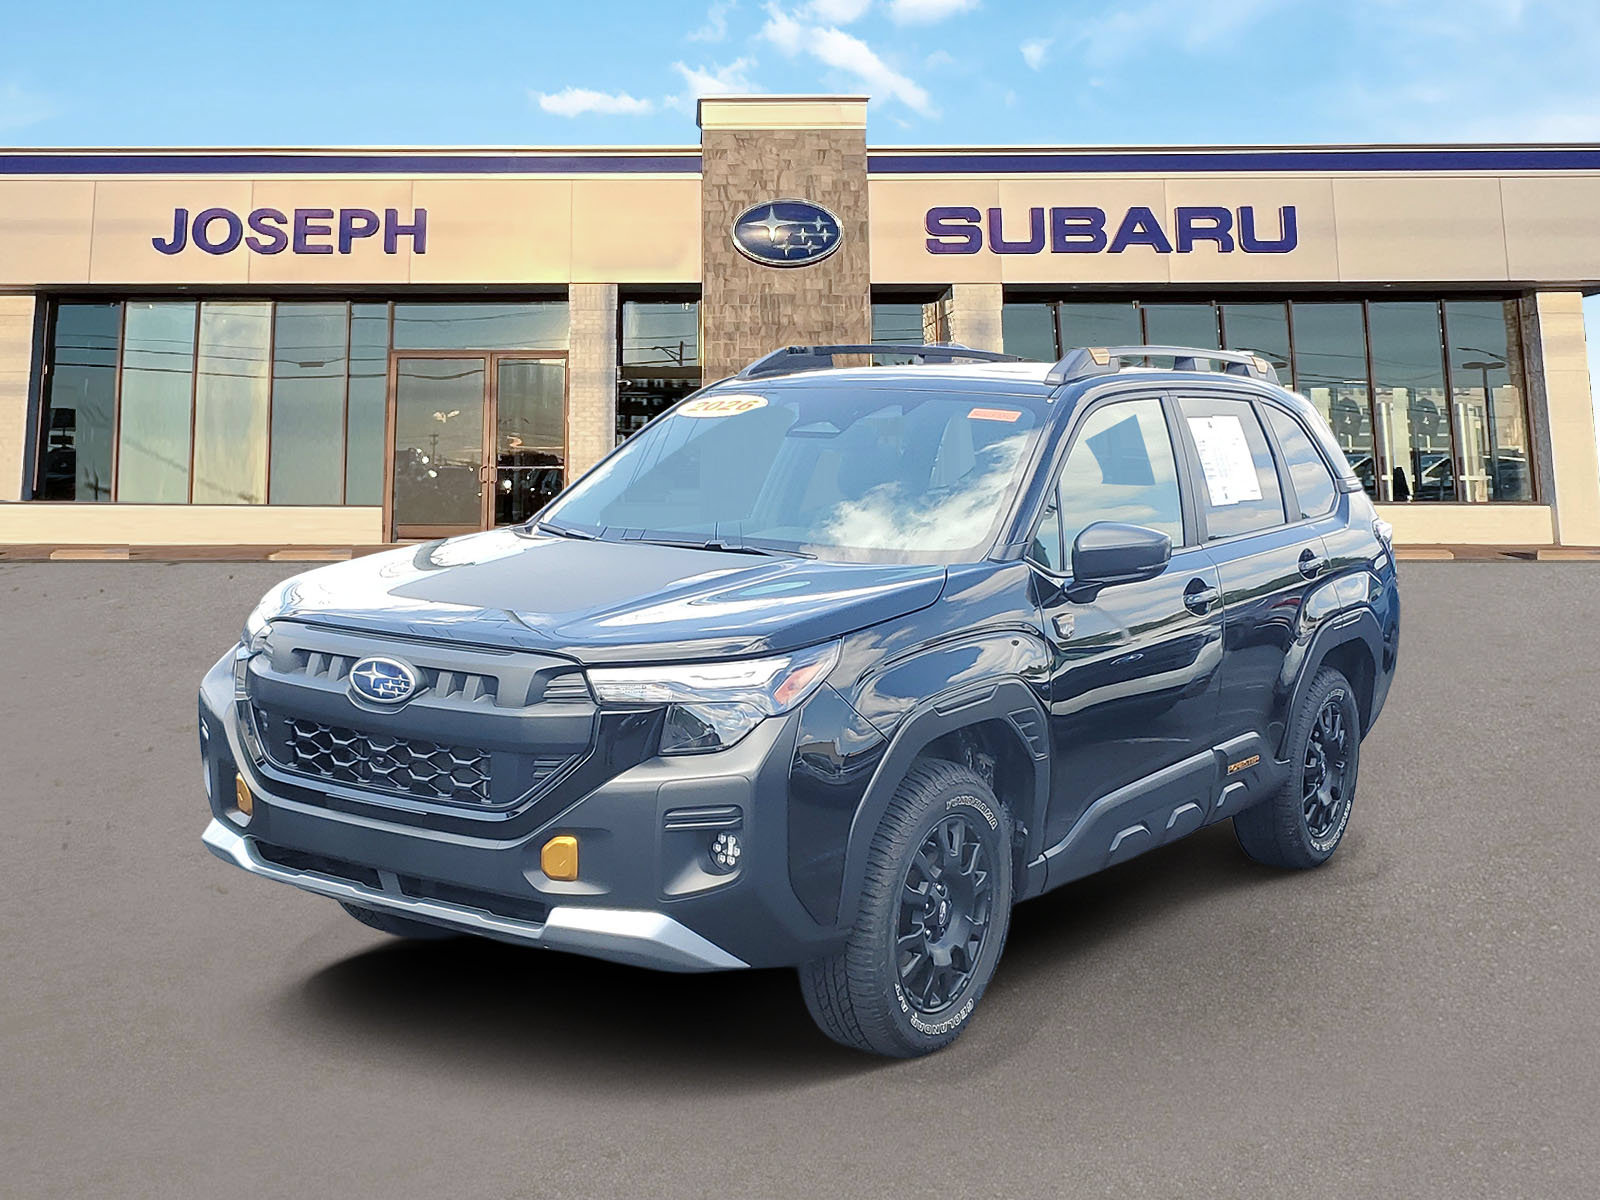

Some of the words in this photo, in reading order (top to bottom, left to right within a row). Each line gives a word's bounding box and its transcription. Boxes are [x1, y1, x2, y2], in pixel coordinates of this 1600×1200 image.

[152, 208, 427, 255] JOSEPH
[925, 205, 1298, 254] SUBARU
[687, 400, 760, 412] 2026
[910, 998, 974, 1035] GEOLANDAR
